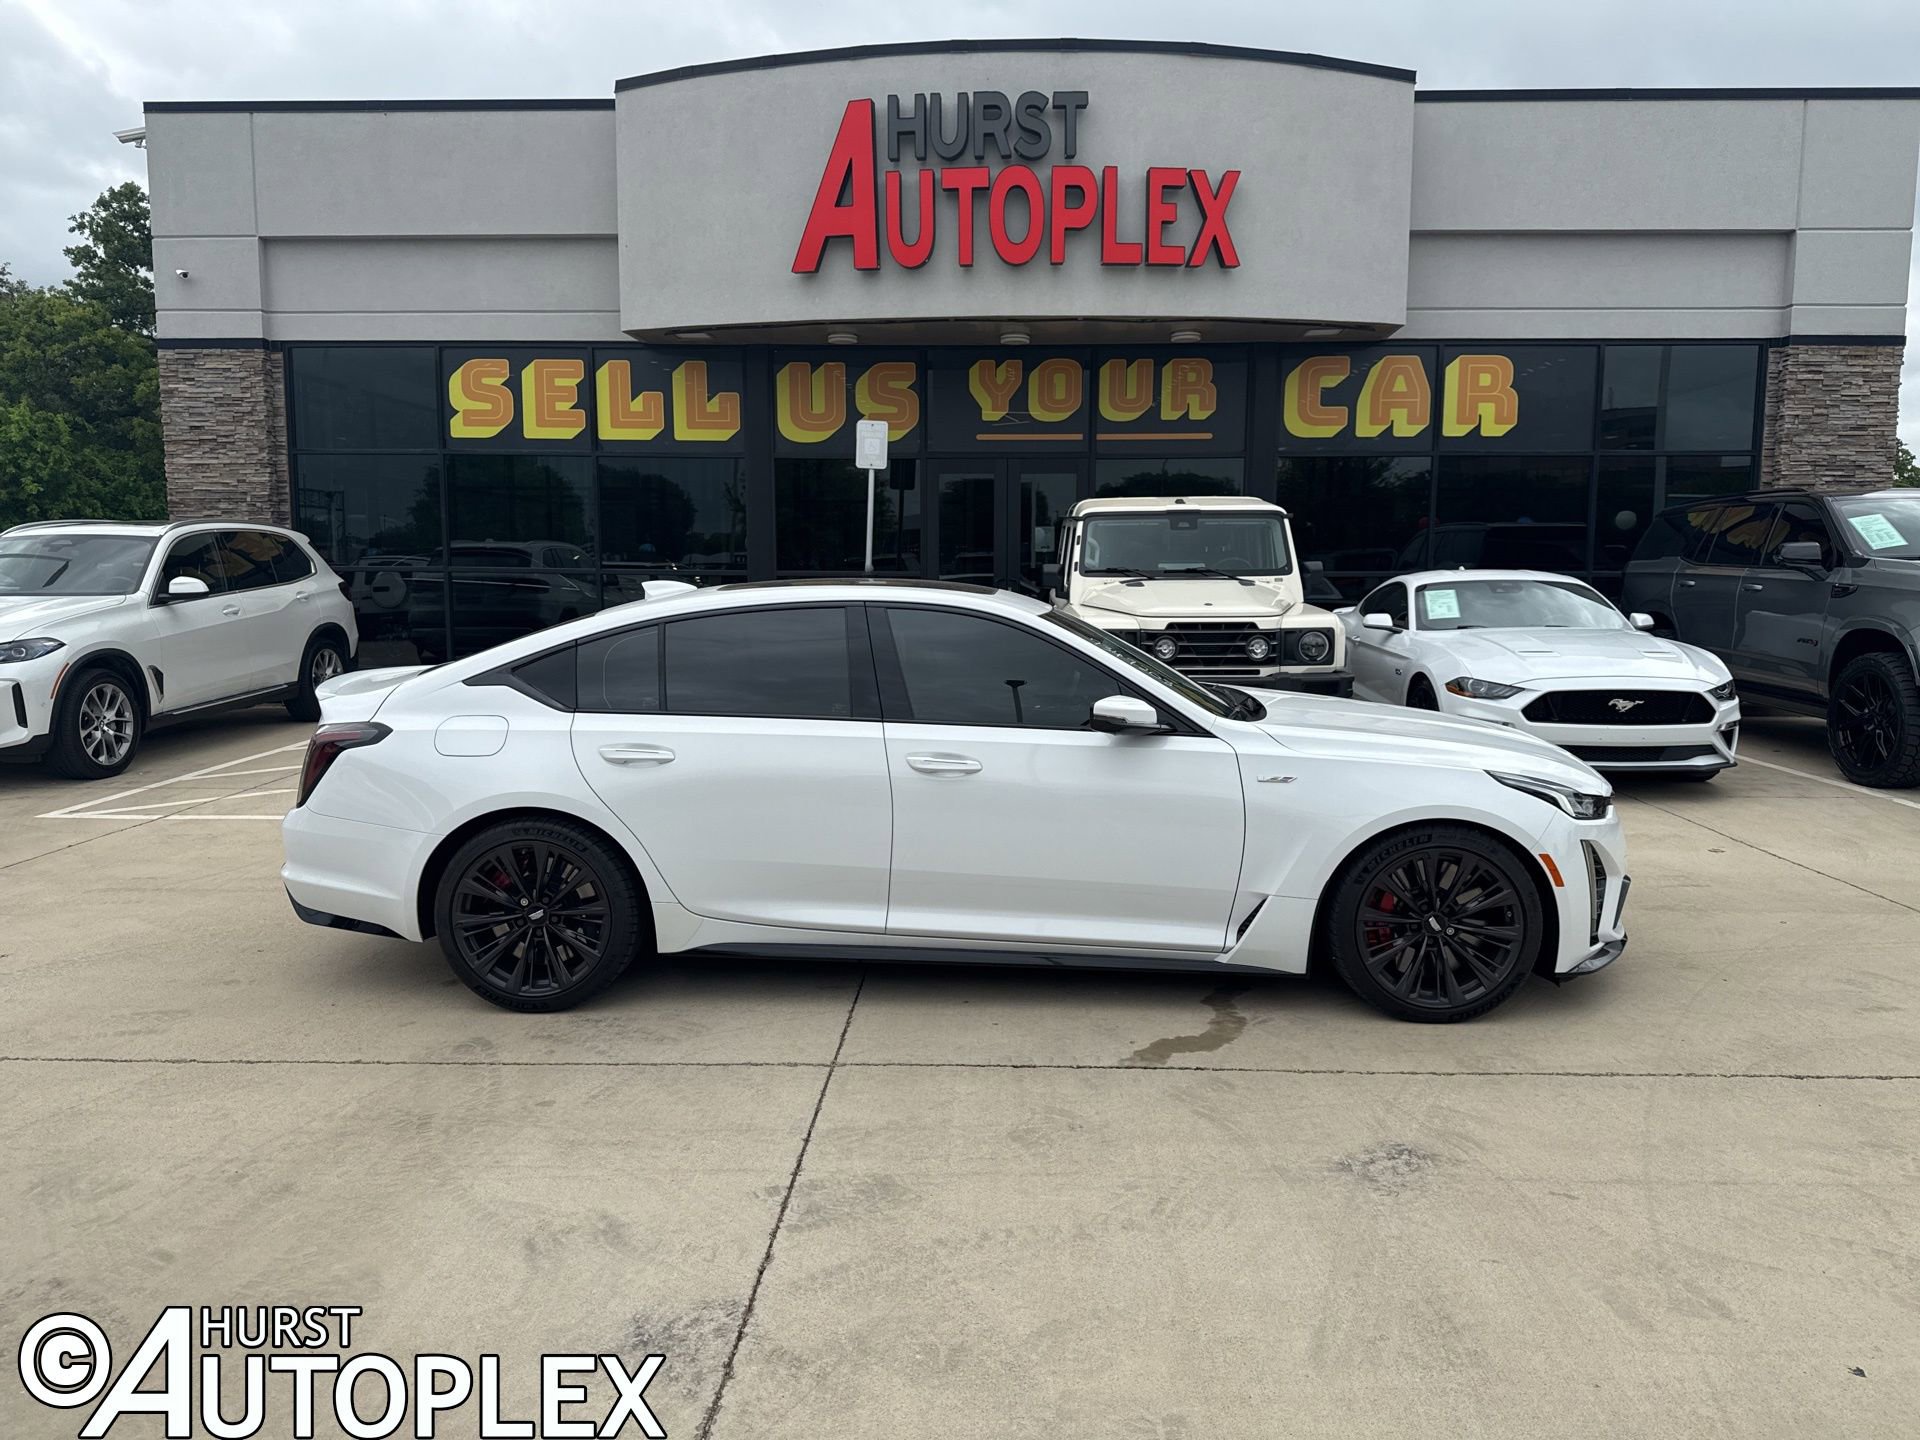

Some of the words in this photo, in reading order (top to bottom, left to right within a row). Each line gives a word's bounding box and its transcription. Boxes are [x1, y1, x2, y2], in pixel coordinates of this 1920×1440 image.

[888, 90, 1089, 162] HURST
[791, 98, 1242, 273] AUTOPLEX
[449, 358, 741, 441] SELL
[776, 361, 920, 443] US
[968, 358, 1217, 422] YOUR
[1283, 354, 1519, 438] CAR
